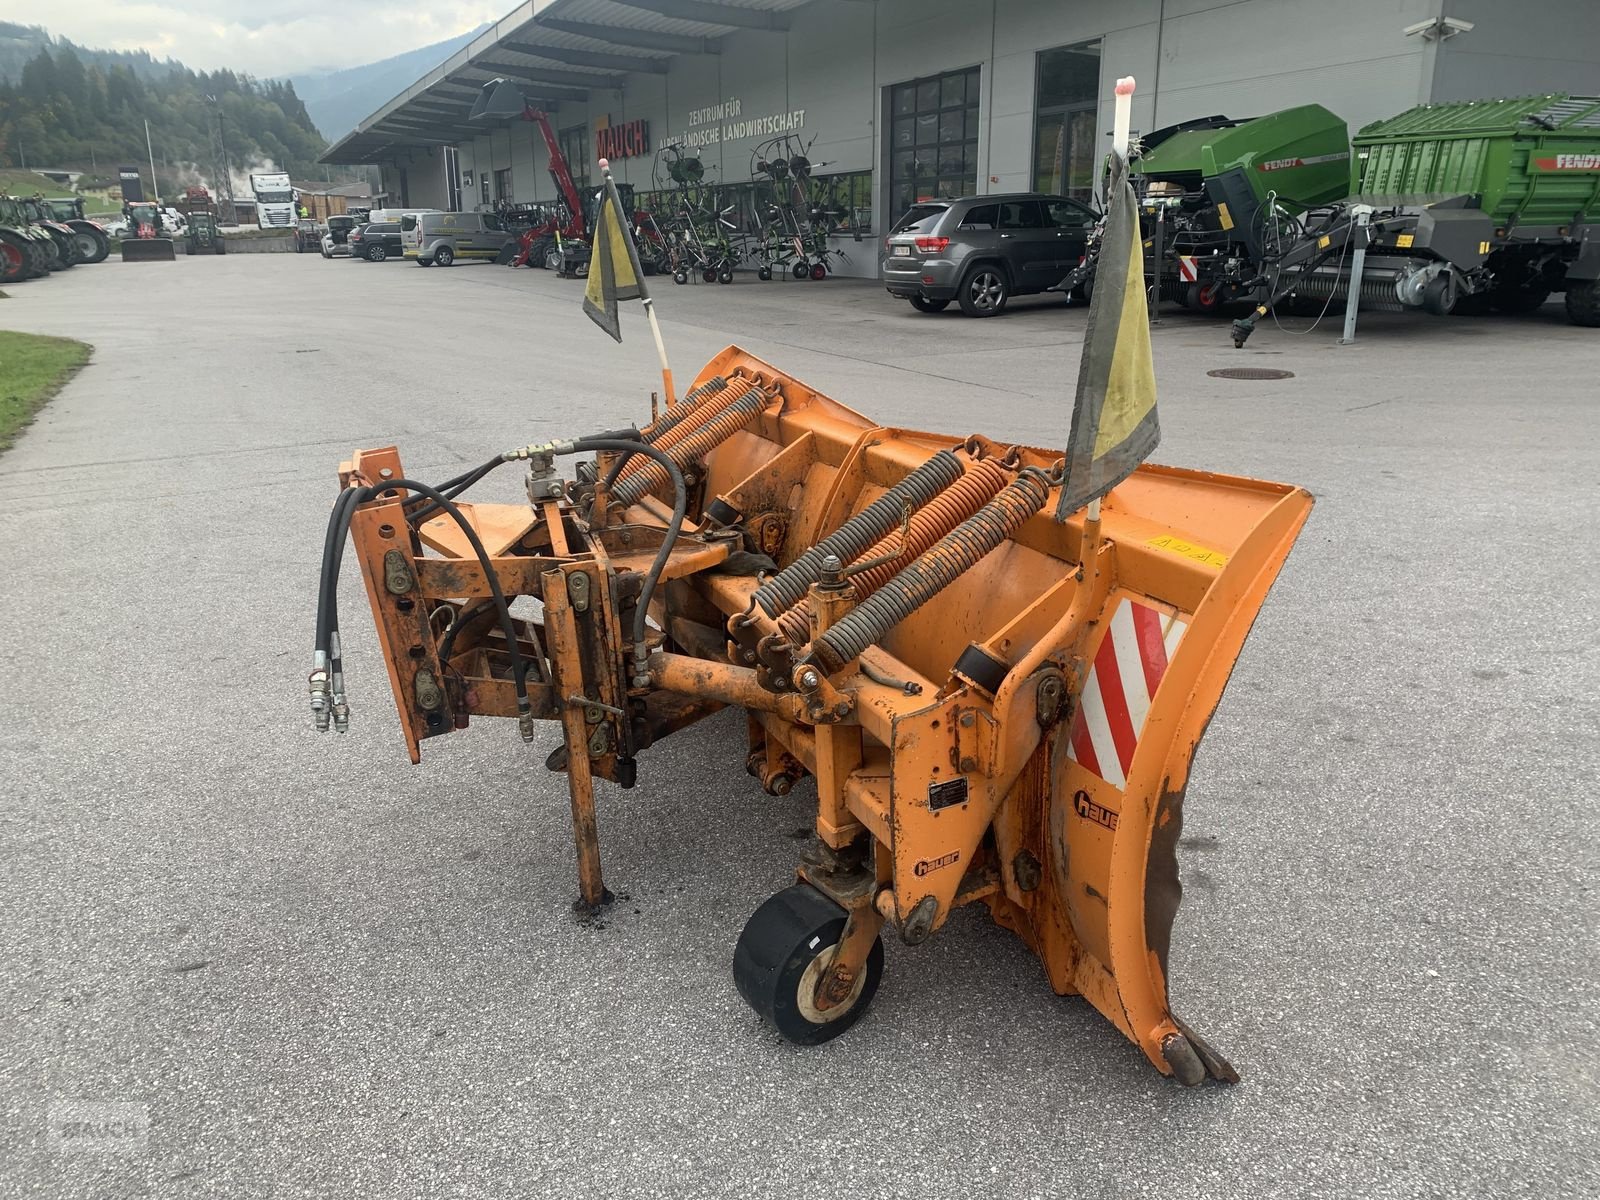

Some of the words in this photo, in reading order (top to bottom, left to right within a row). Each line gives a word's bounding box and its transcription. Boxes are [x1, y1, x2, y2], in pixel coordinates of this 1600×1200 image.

[689, 103, 724, 126] ZENTRUM
[725, 97, 741, 118] FÜR
[722, 109, 805, 140] LANDWIRTSCHAFT
[596, 119, 646, 162] MAUCH
[1263, 157, 1299, 171] FENDT
[1077, 791, 1118, 829] haue
[917, 851, 959, 876] hauer
